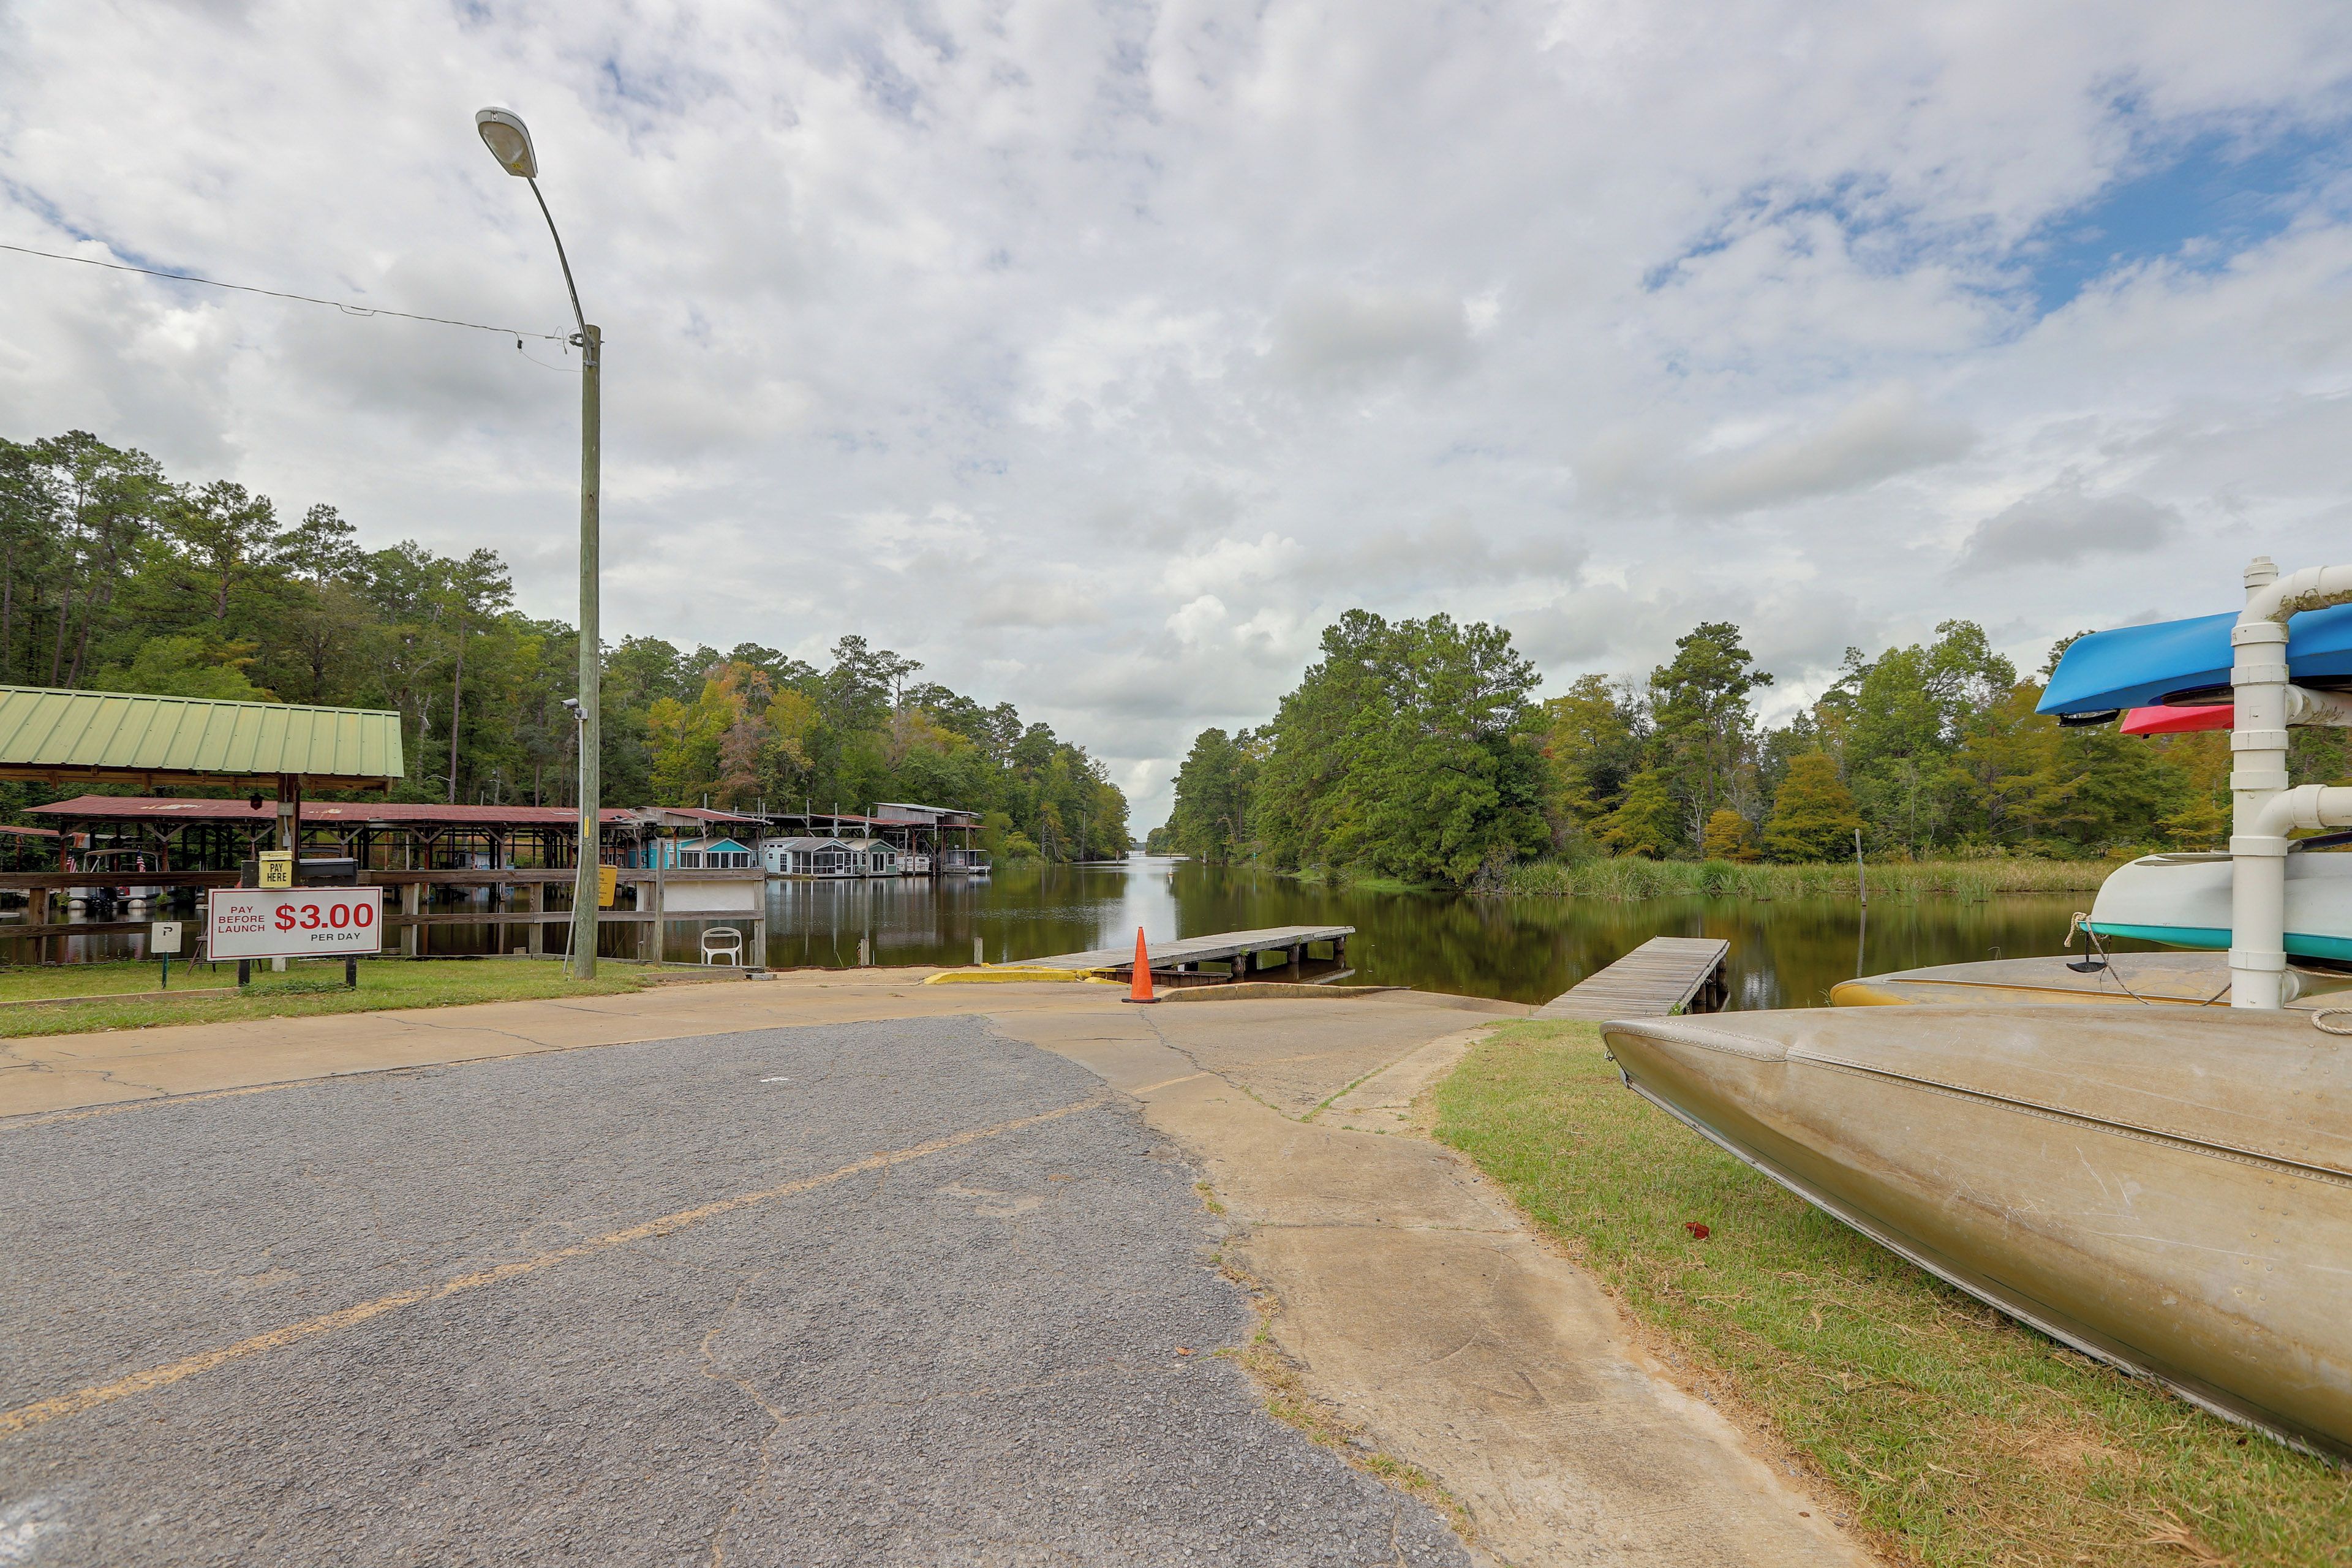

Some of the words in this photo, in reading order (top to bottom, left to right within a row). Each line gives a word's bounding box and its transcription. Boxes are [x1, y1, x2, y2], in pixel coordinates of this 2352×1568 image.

[270, 863, 283, 873] PAY
[267, 872, 287, 882] HERE
[219, 915, 265, 924] BEFORE
[274, 903, 373, 933] $3.00
[218, 924, 265, 933] LAUNCH
